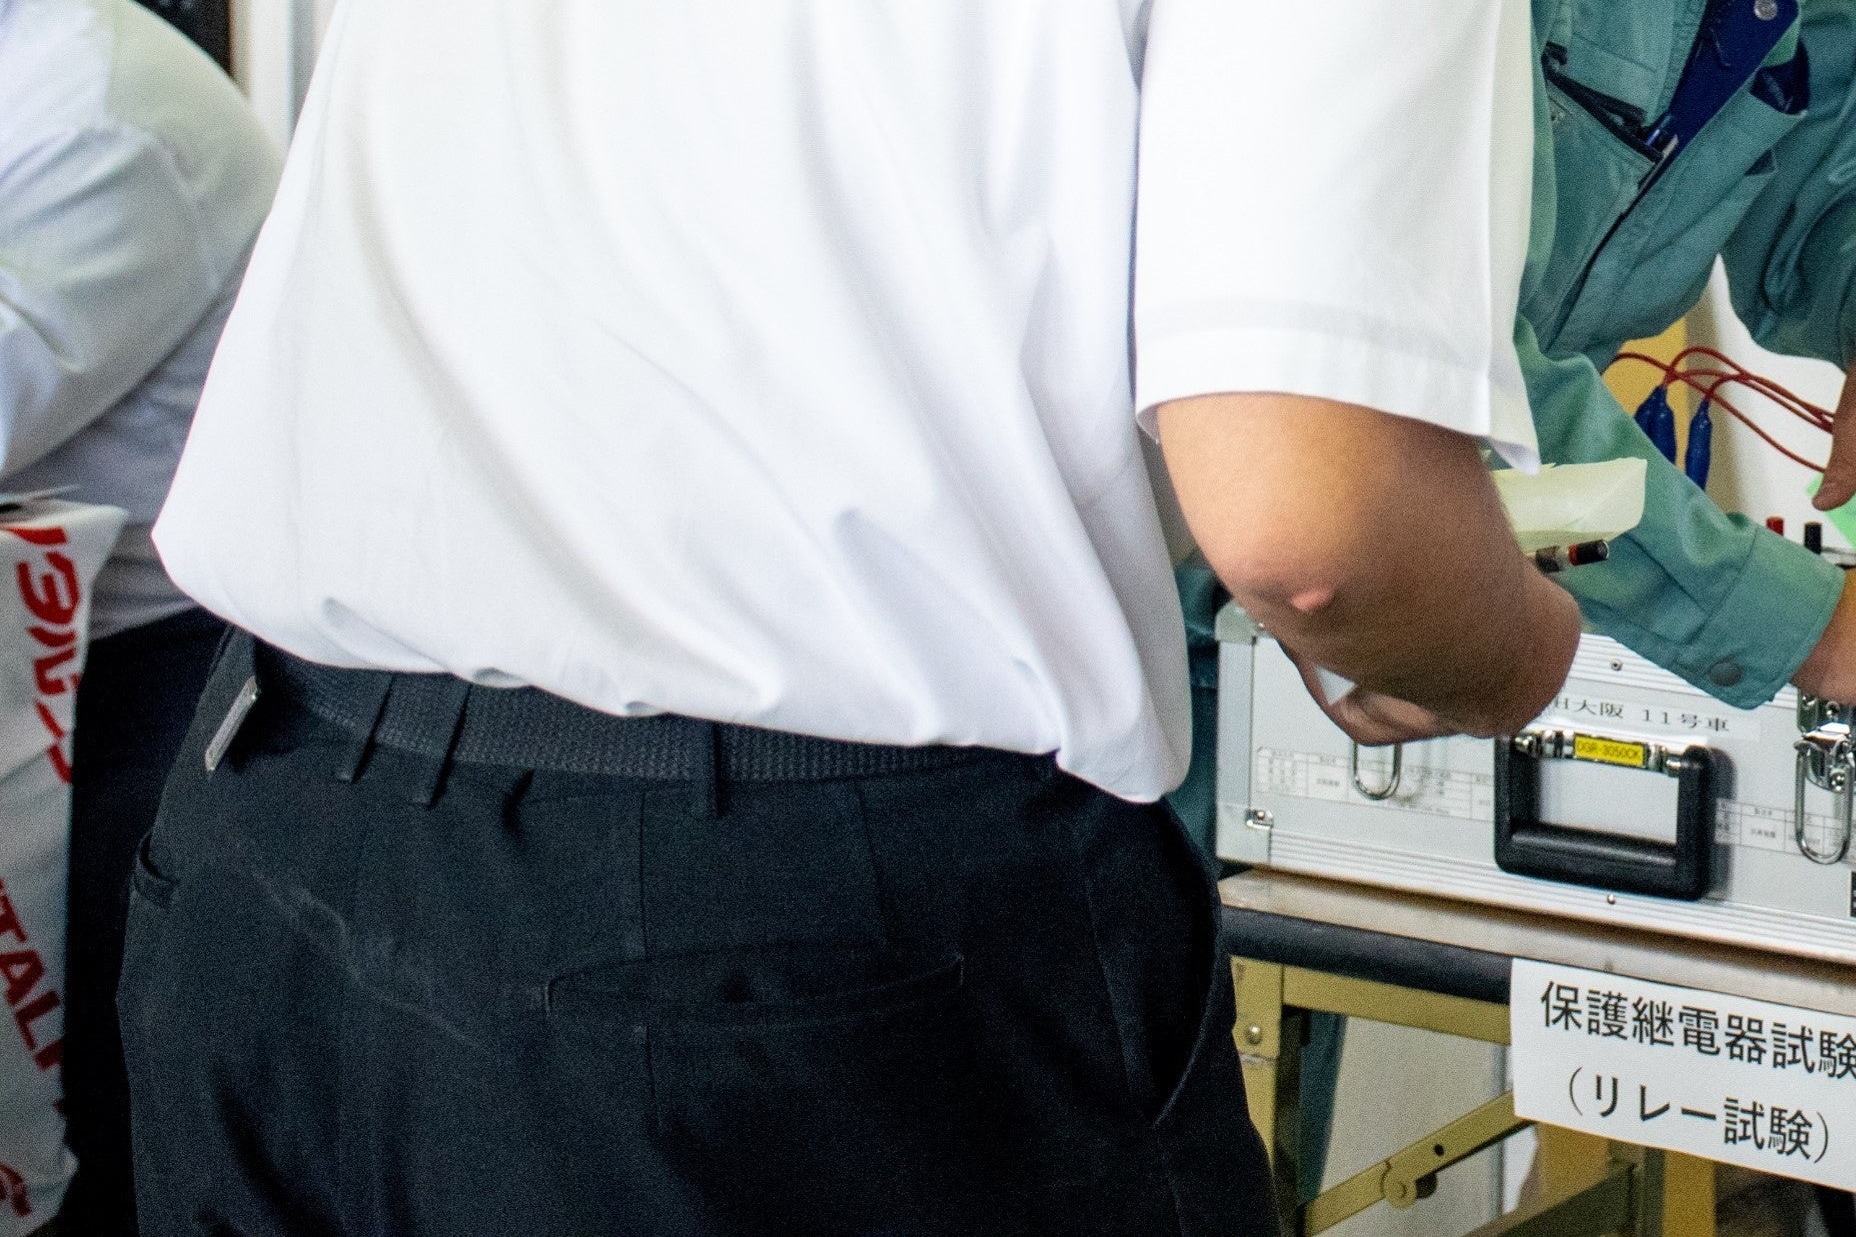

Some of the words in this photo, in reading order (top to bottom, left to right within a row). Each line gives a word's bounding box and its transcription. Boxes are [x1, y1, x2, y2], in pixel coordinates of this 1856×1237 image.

[1568, 1066, 1830, 1164] (リレー試験)
